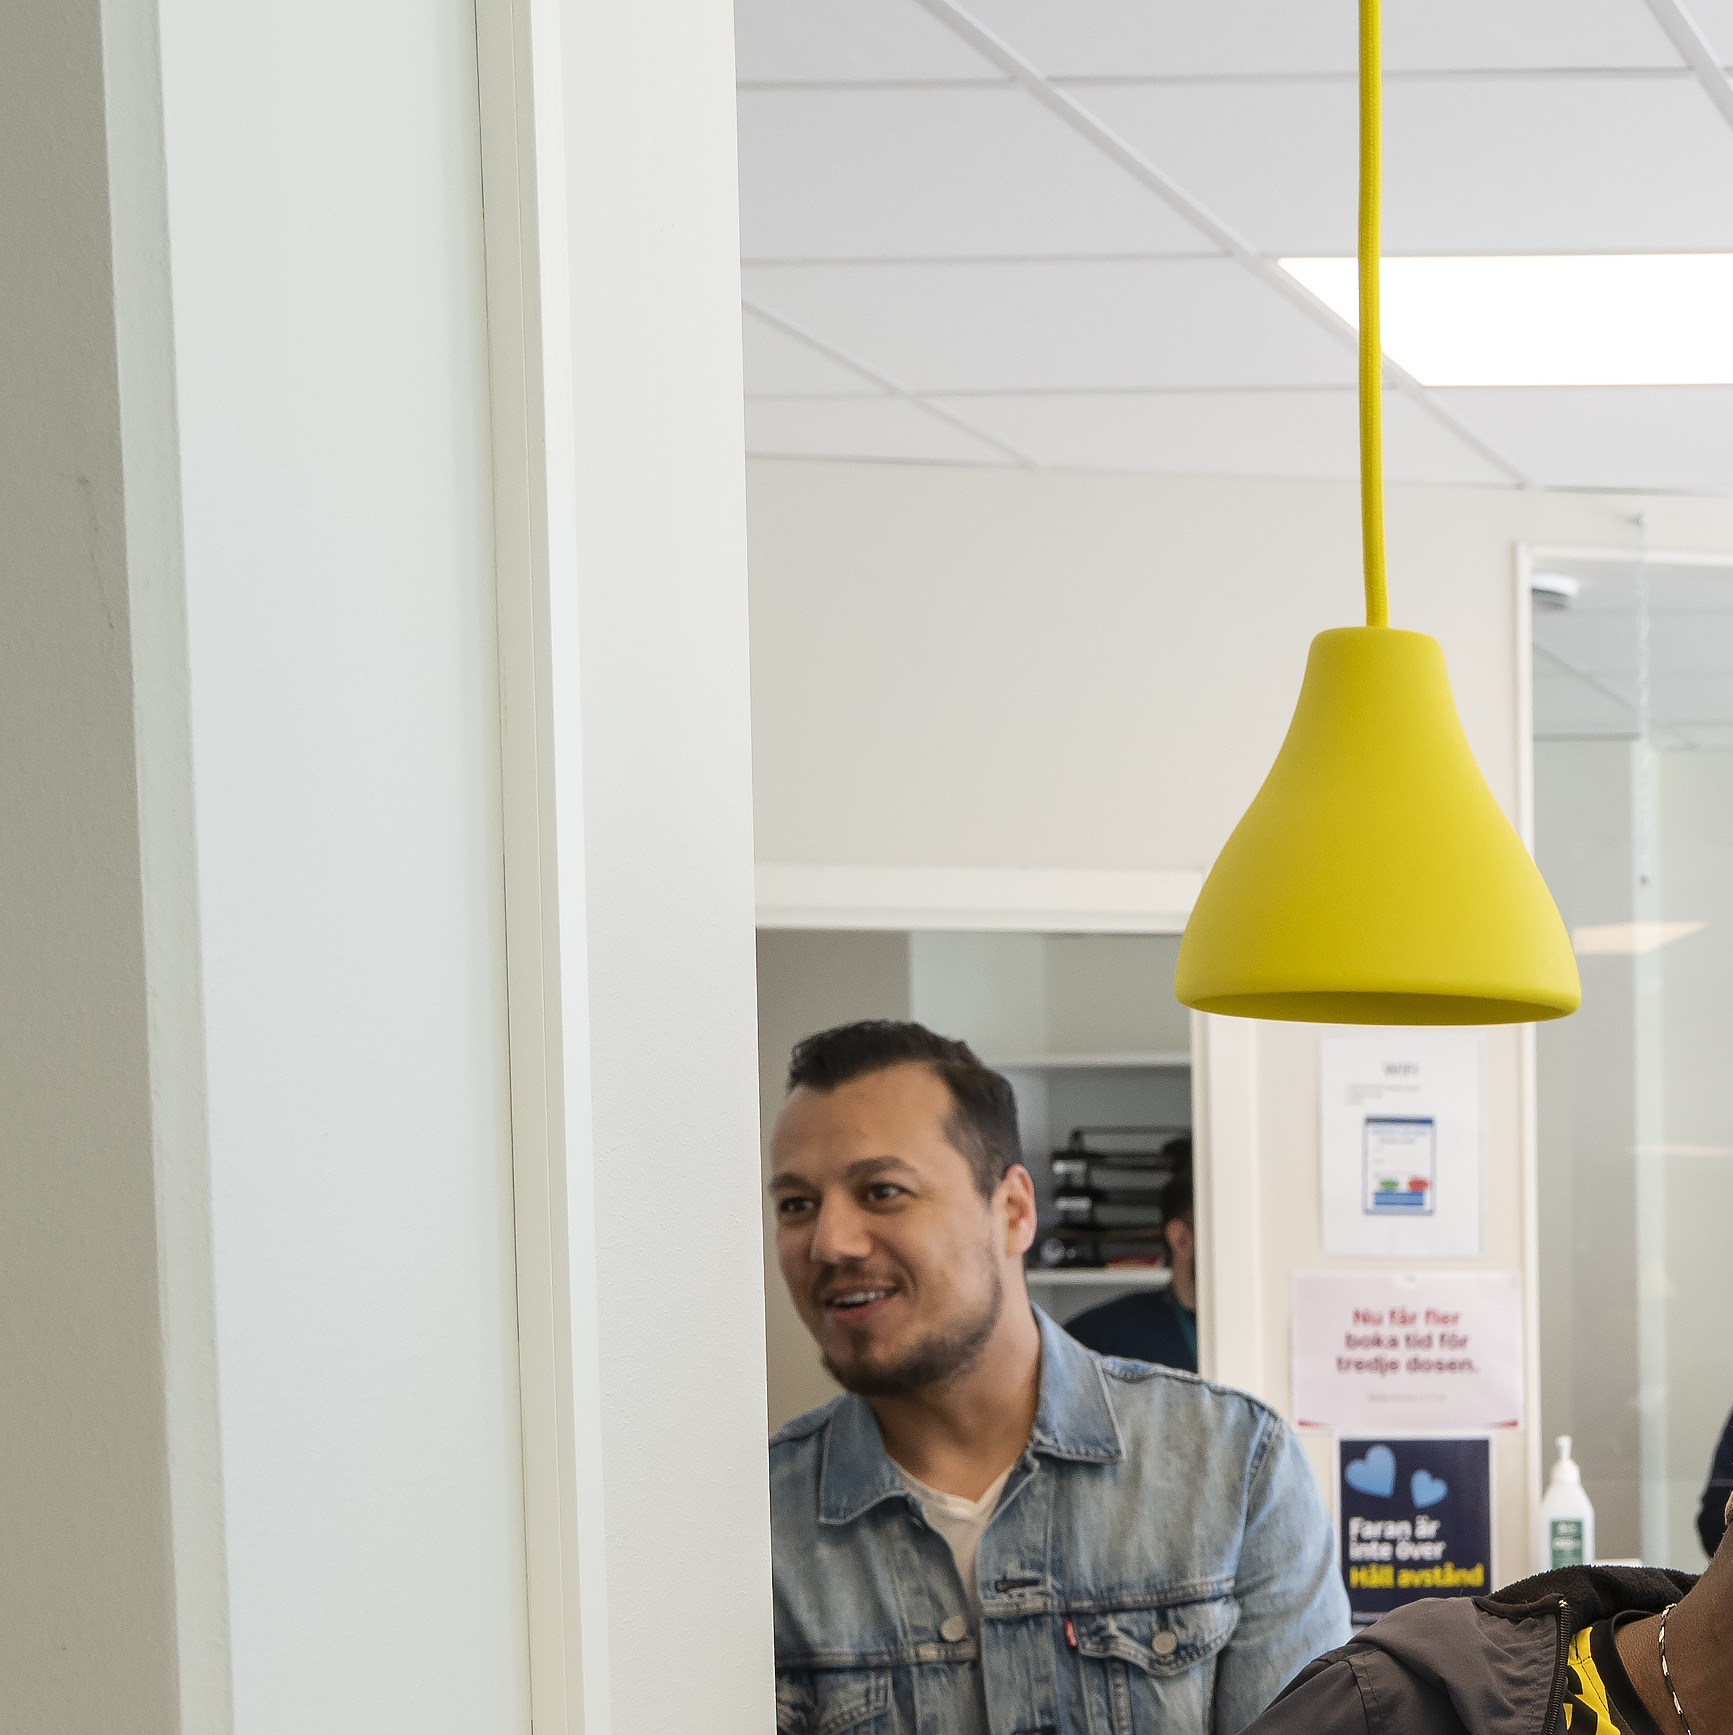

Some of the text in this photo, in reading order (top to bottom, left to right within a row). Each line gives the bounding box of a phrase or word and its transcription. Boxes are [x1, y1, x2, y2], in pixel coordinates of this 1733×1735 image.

[1352, 1305, 1460, 1326] Nu får fler
[1345, 1331, 1468, 1349] boka tid för
[1336, 1355, 1478, 1378] tredje dosen.
[1350, 1514, 1441, 1540] Faran är
[1350, 1561, 1484, 1588] Håll avstånd
